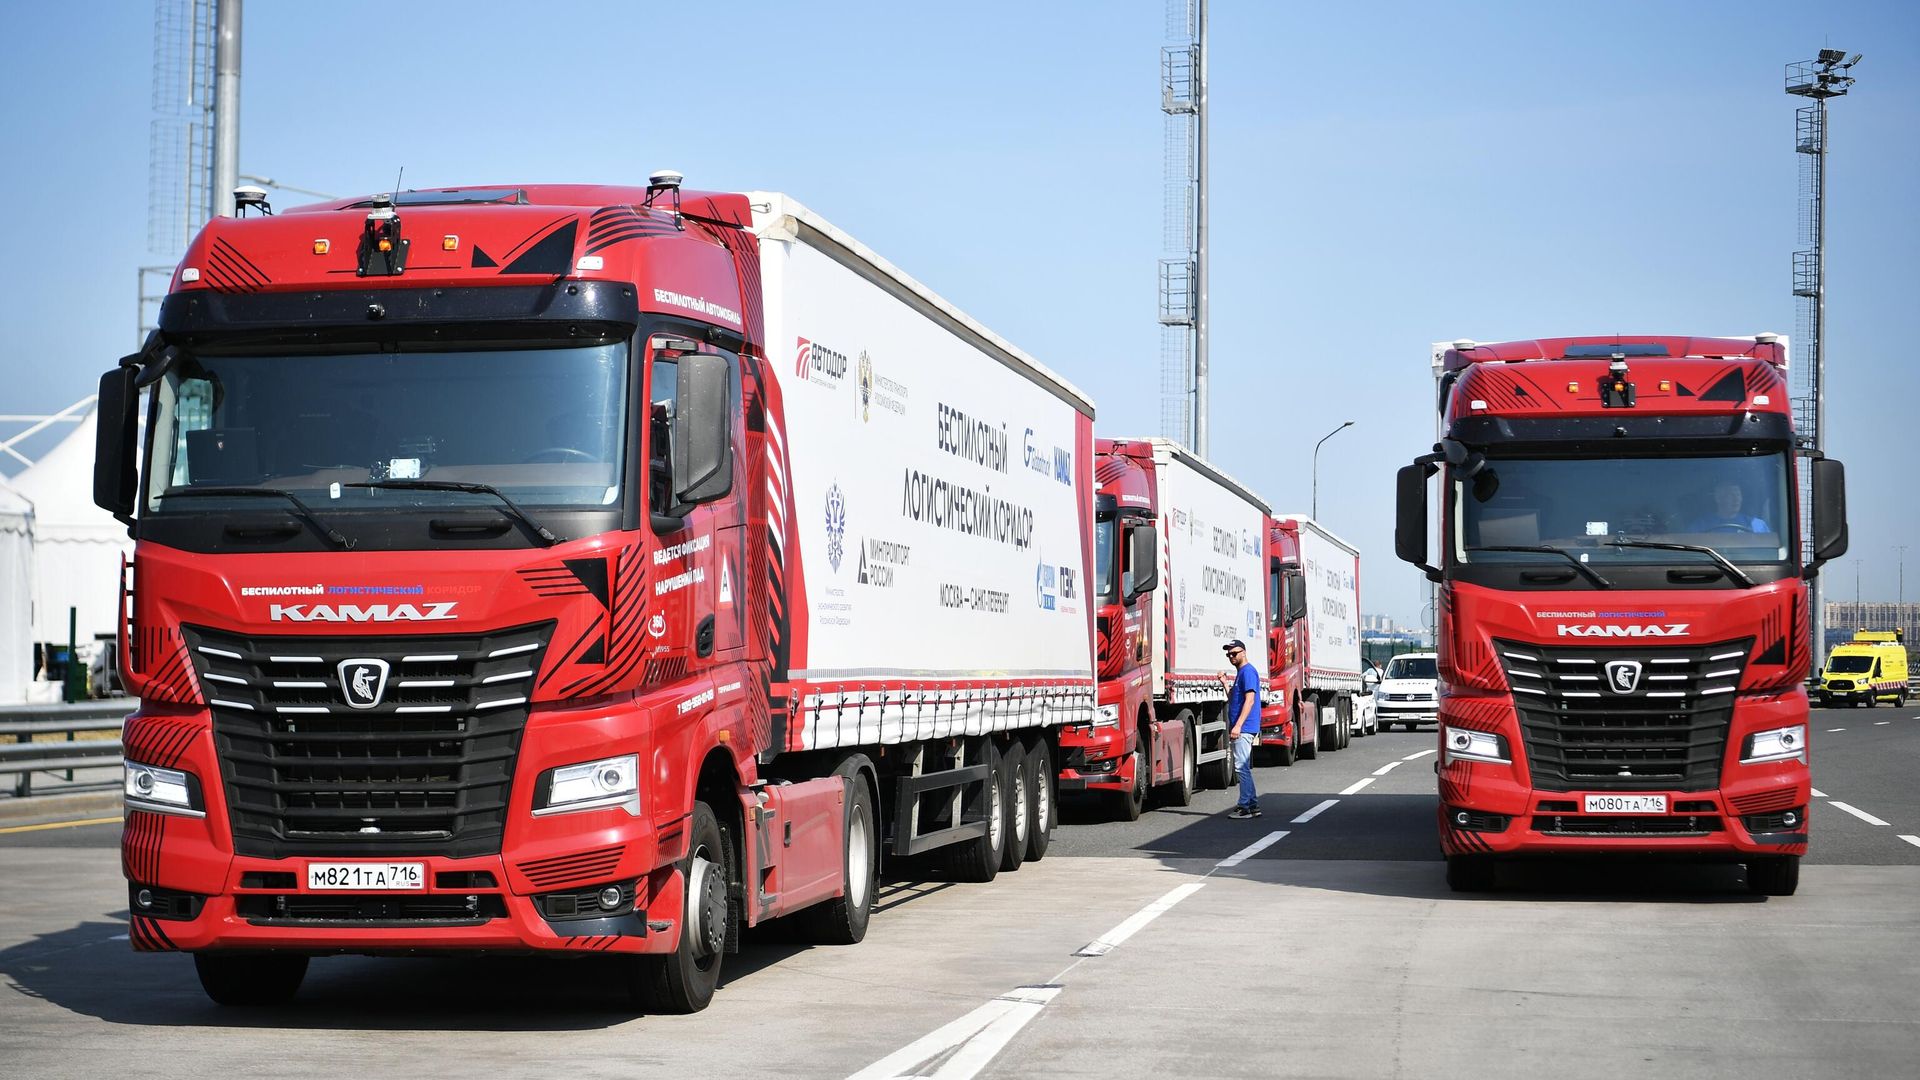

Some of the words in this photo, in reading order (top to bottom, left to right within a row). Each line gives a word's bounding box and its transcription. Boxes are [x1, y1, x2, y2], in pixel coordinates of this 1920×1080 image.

[654, 288, 705, 313] БЕСПИЛОТНЫЙ
[706, 302, 741, 325] АВТОМОБИЛЬ
[811, 342, 847, 380] АВТОДОР
[938, 402, 1007, 475] БЕСПИЛОТНЫЙ
[903, 467, 991, 540] ЛОГИСТИЧЕСКИЙ
[993, 498, 1033, 553] КОРИДОР
[653, 544, 682, 566] ВЕДЕТСЯ
[682, 534, 710, 556] ФИКСАЦИЯ
[241, 583, 324, 596] БЕСПИЛОТНЫЙ
[328, 584, 423, 595] ЛОГИСТИЧЕСКИЙ
[427, 585, 482, 596] КОРИДОР
[655, 567, 693, 597] НАРУШЕНИЙ
[269, 602, 459, 622] KAMAZ
[1536, 610, 1596, 618] БЕСПИЛОТНЫЙ
[1598, 610, 1665, 618] ЛОГИСТИЧЕСКИЙ
[1557, 624, 1691, 637] KAMAZ
[1589, 798, 1640, 811] М080ТА
[1642, 797, 1664, 808] 716
[314, 867, 386, 886] М821ТА
[390, 866, 417, 881] 716
